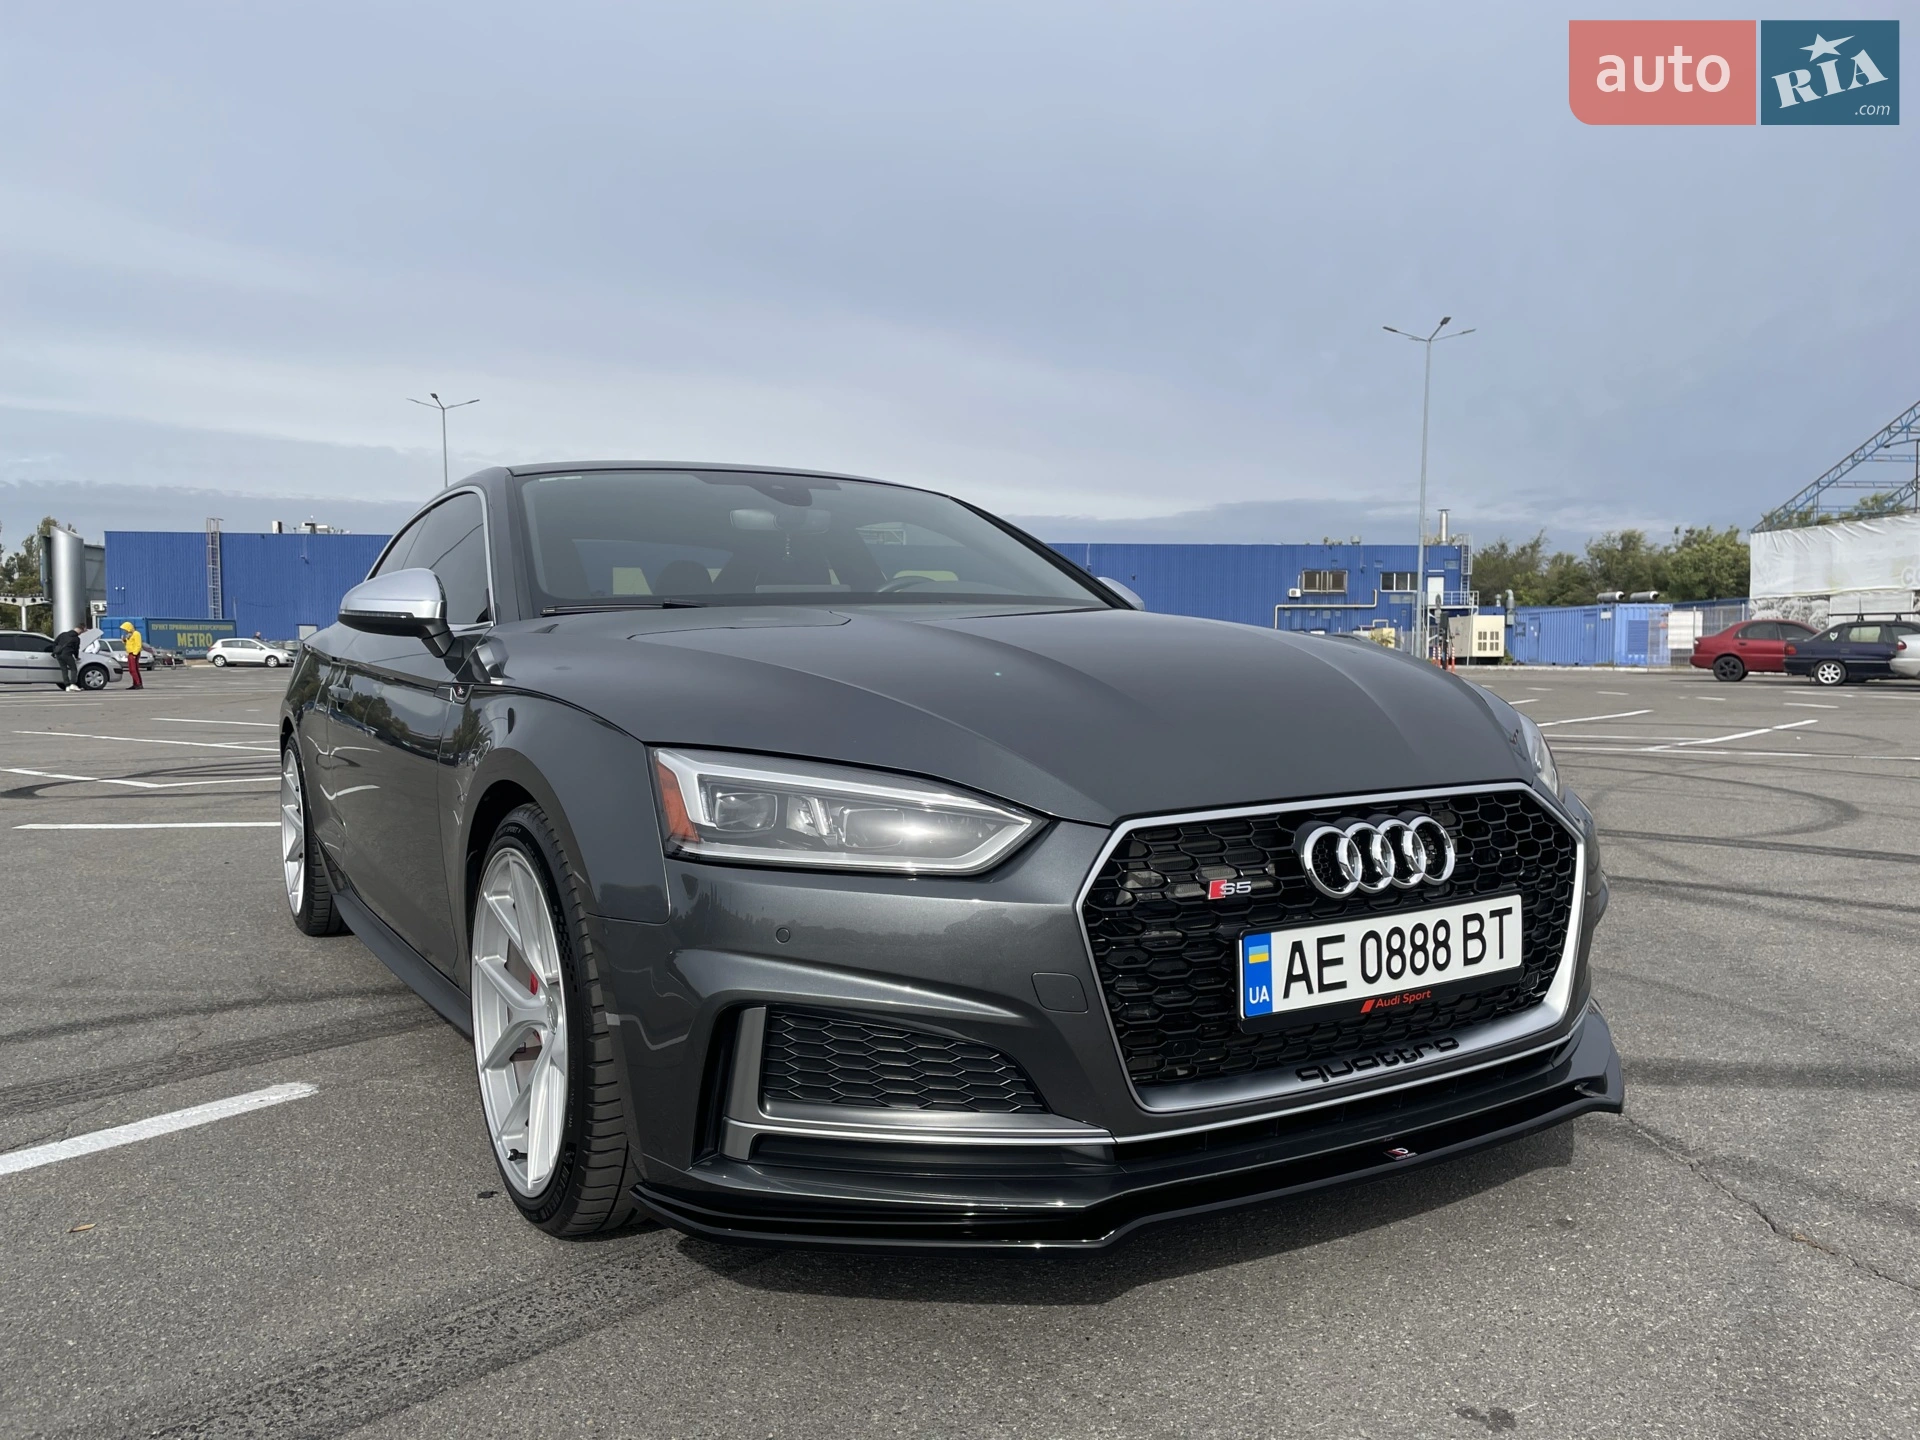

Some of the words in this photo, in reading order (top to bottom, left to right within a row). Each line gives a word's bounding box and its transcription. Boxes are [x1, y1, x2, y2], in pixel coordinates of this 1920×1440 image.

[177, 632, 213, 647] METRO
[1220, 880, 1252, 895] S5
[1283, 934, 1347, 999] AE
[1360, 919, 1451, 985] 0888
[1463, 906, 1513, 967] BT
[1249, 985, 1270, 1004] UA
[1375, 993, 1401, 1008] Audi
[1402, 990, 1431, 1005] Sport
[1295, 1037, 1460, 1082] quattro
